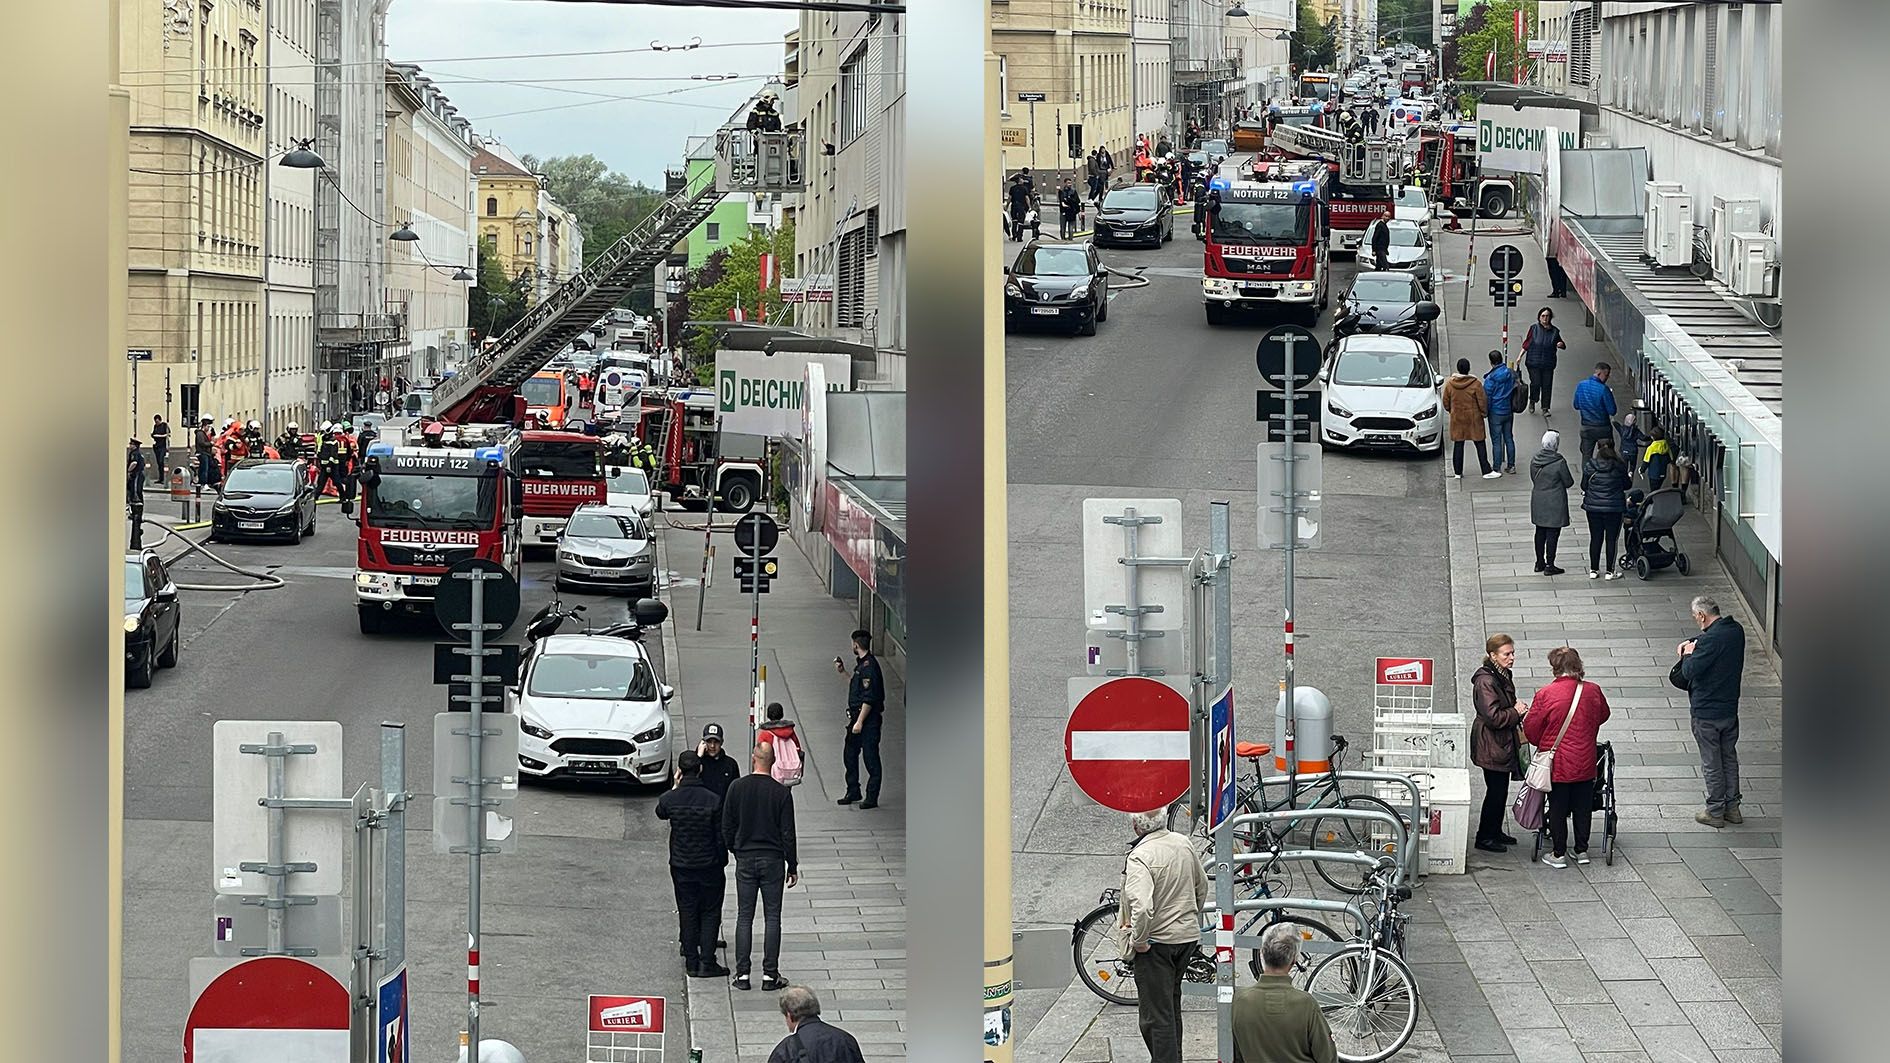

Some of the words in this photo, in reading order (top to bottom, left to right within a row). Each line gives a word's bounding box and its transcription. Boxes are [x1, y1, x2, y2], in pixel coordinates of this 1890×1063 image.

[1495, 126, 1575, 151] DEICHMNN
[1233, 190, 1271, 199] NOTRUF
[1273, 191, 1289, 199] 122
[1221, 245, 1297, 256] FEUERWEHR
[397, 457, 445, 468] NOTRUF
[450, 459, 469, 469] 122
[380, 530, 479, 543] FEUERWEHR
[606, 1016, 638, 1025] KURIER
